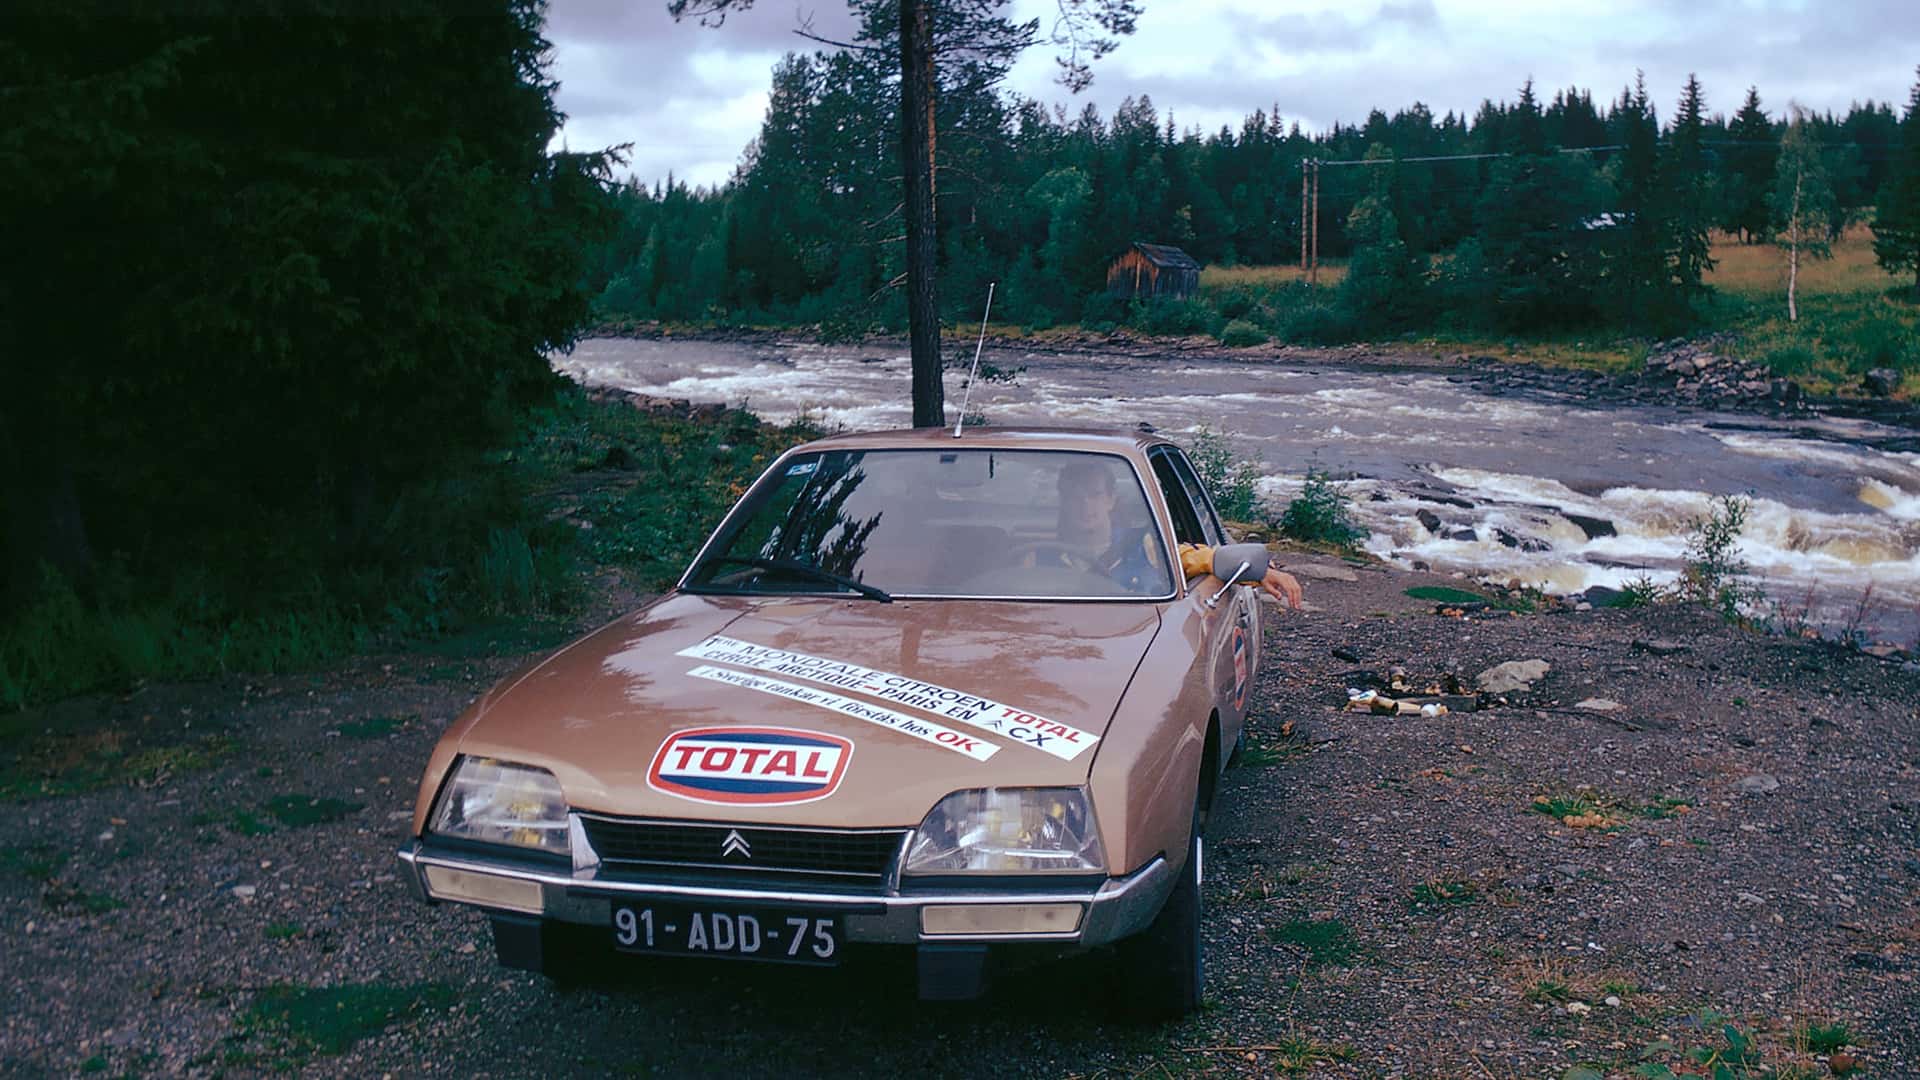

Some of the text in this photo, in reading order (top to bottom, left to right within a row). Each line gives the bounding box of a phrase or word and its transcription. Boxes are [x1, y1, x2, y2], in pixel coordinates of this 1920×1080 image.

[704, 651, 770, 667] CERCLE
[945, 706, 978, 721] EN
[1008, 727, 1053, 747] CX
[739, 646, 883, 680] MONDIALE
[885, 677, 995, 711] CITROEN
[1002, 708, 1081, 743] TOTAL
[766, 684, 820, 701] tankar
[899, 720, 933, 736] hos
[935, 731, 982, 752] OK
[675, 746, 829, 778] TOTAL
